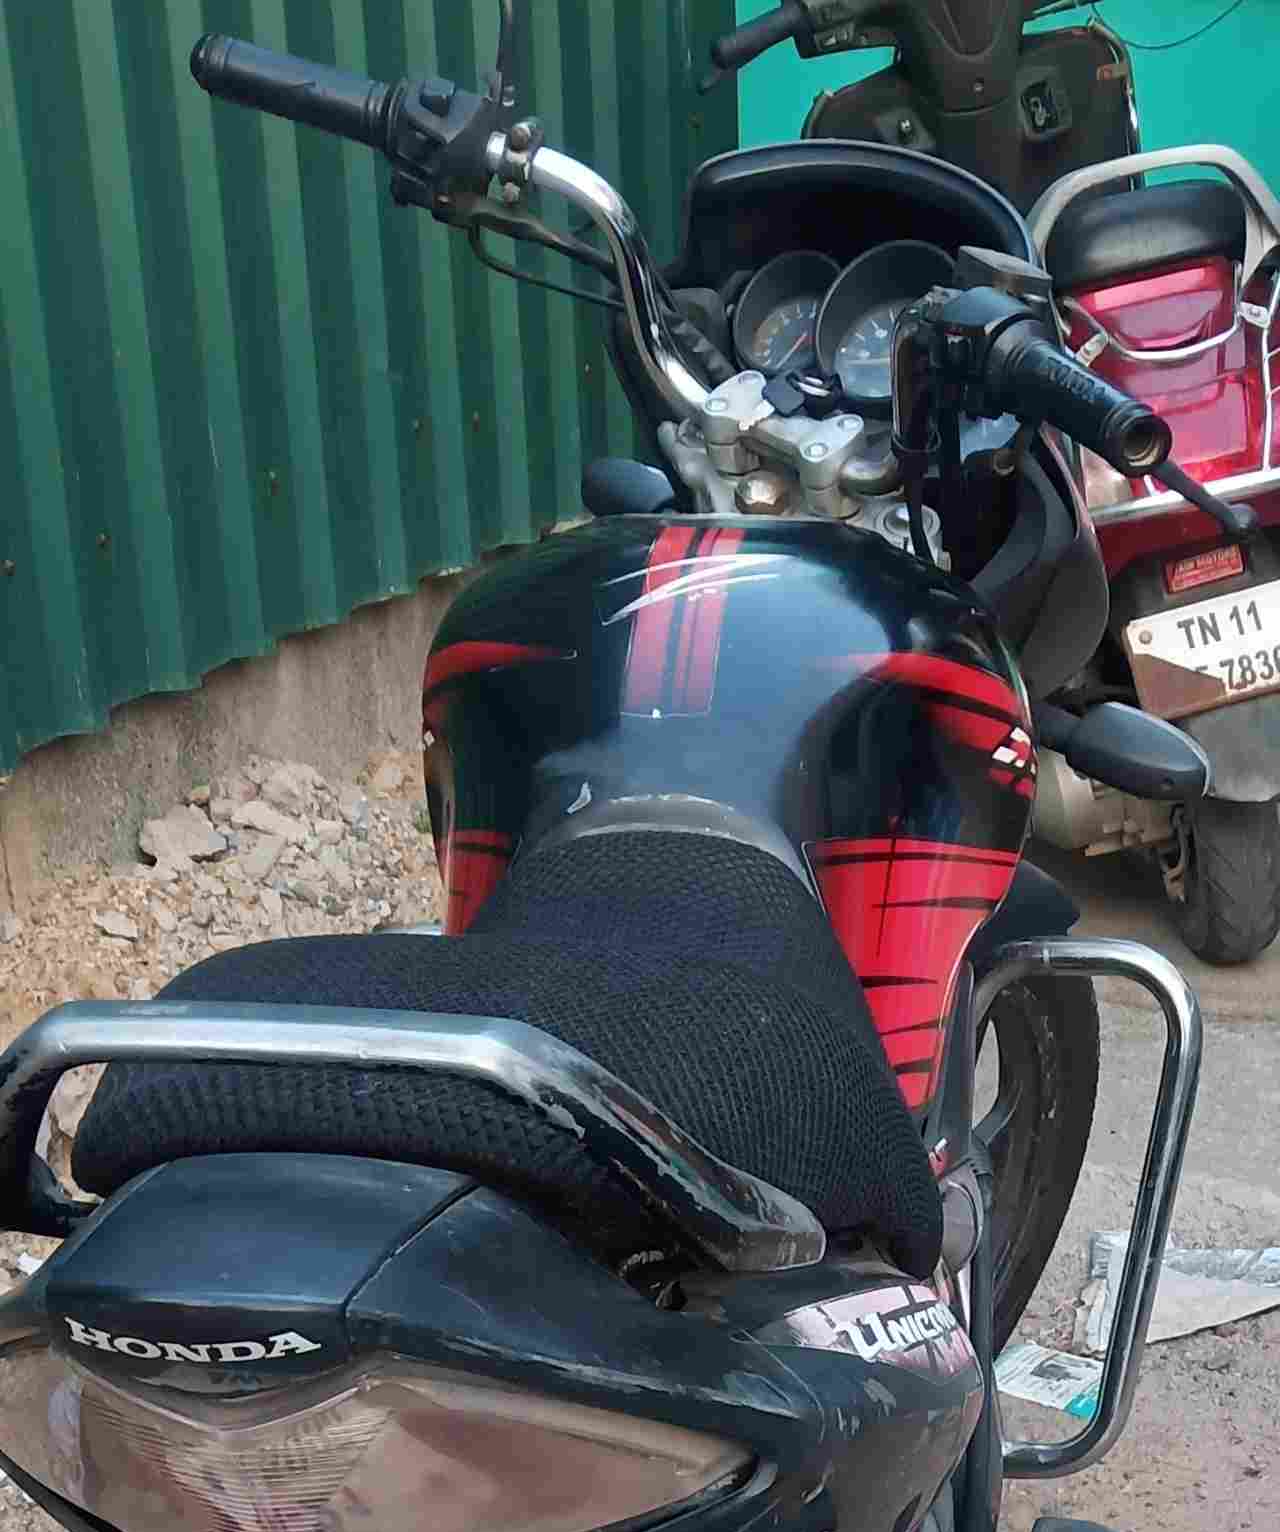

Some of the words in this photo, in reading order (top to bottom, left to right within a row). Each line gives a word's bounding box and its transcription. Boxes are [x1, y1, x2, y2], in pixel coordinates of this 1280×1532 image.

[1177, 612, 1222, 649] TN
[1229, 600, 1262, 636] 11
[64, 1316, 322, 1362] HONDA
